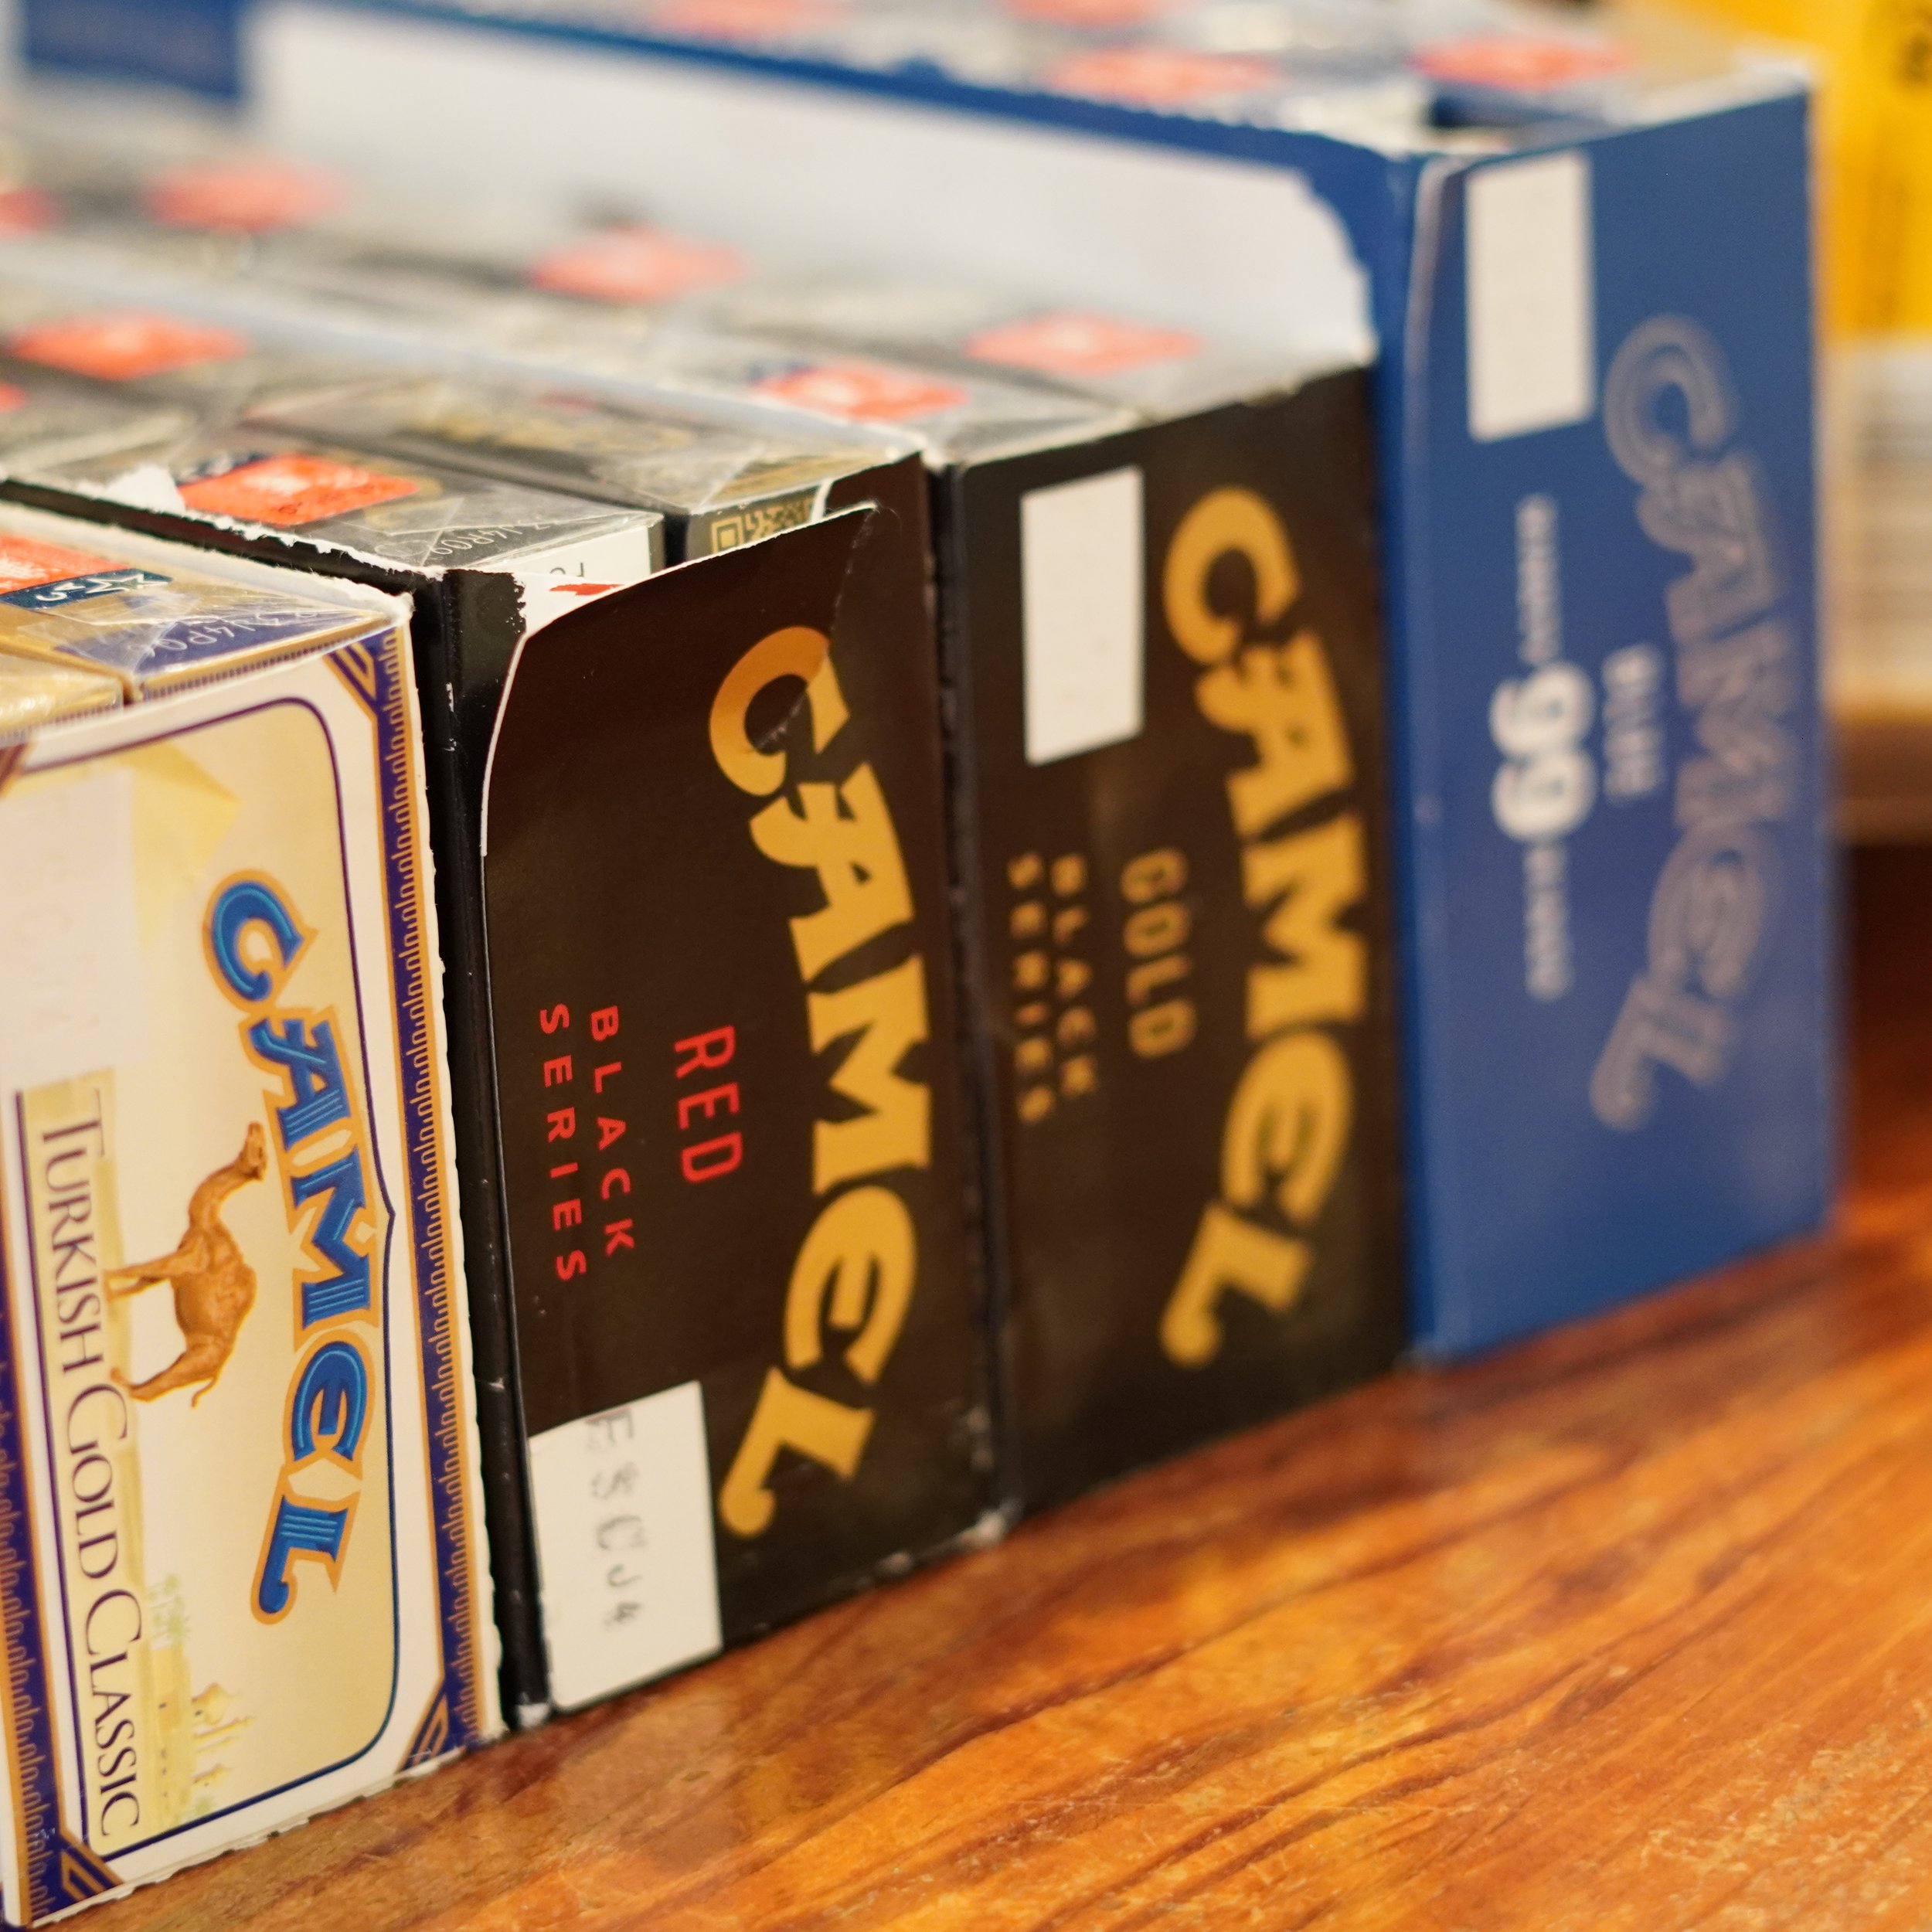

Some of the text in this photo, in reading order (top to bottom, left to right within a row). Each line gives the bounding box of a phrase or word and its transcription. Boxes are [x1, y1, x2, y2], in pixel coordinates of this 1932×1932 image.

[1488, 661, 1597, 844] 99
[1590, 313, 1791, 1131] CAMEL
[1007, 852, 1056, 1126] SERIES
[1050, 852, 1099, 1100] BLACK
[1119, 848, 1197, 1059] GOLD
[1162, 485, 1369, 1365] CAMEL
[540, 1003, 587, 1281] SERIES
[590, 1005, 635, 1257] BLACK
[674, 1025, 743, 1183] RED
[709, 626, 932, 1536] CAMEL
[42, 1088, 105, 1374] TURKISH
[204, 869, 377, 1626] CAMEL
[66, 1383, 128, 1580] GOLD
[85, 1588, 143, 1836] CLASSIC
